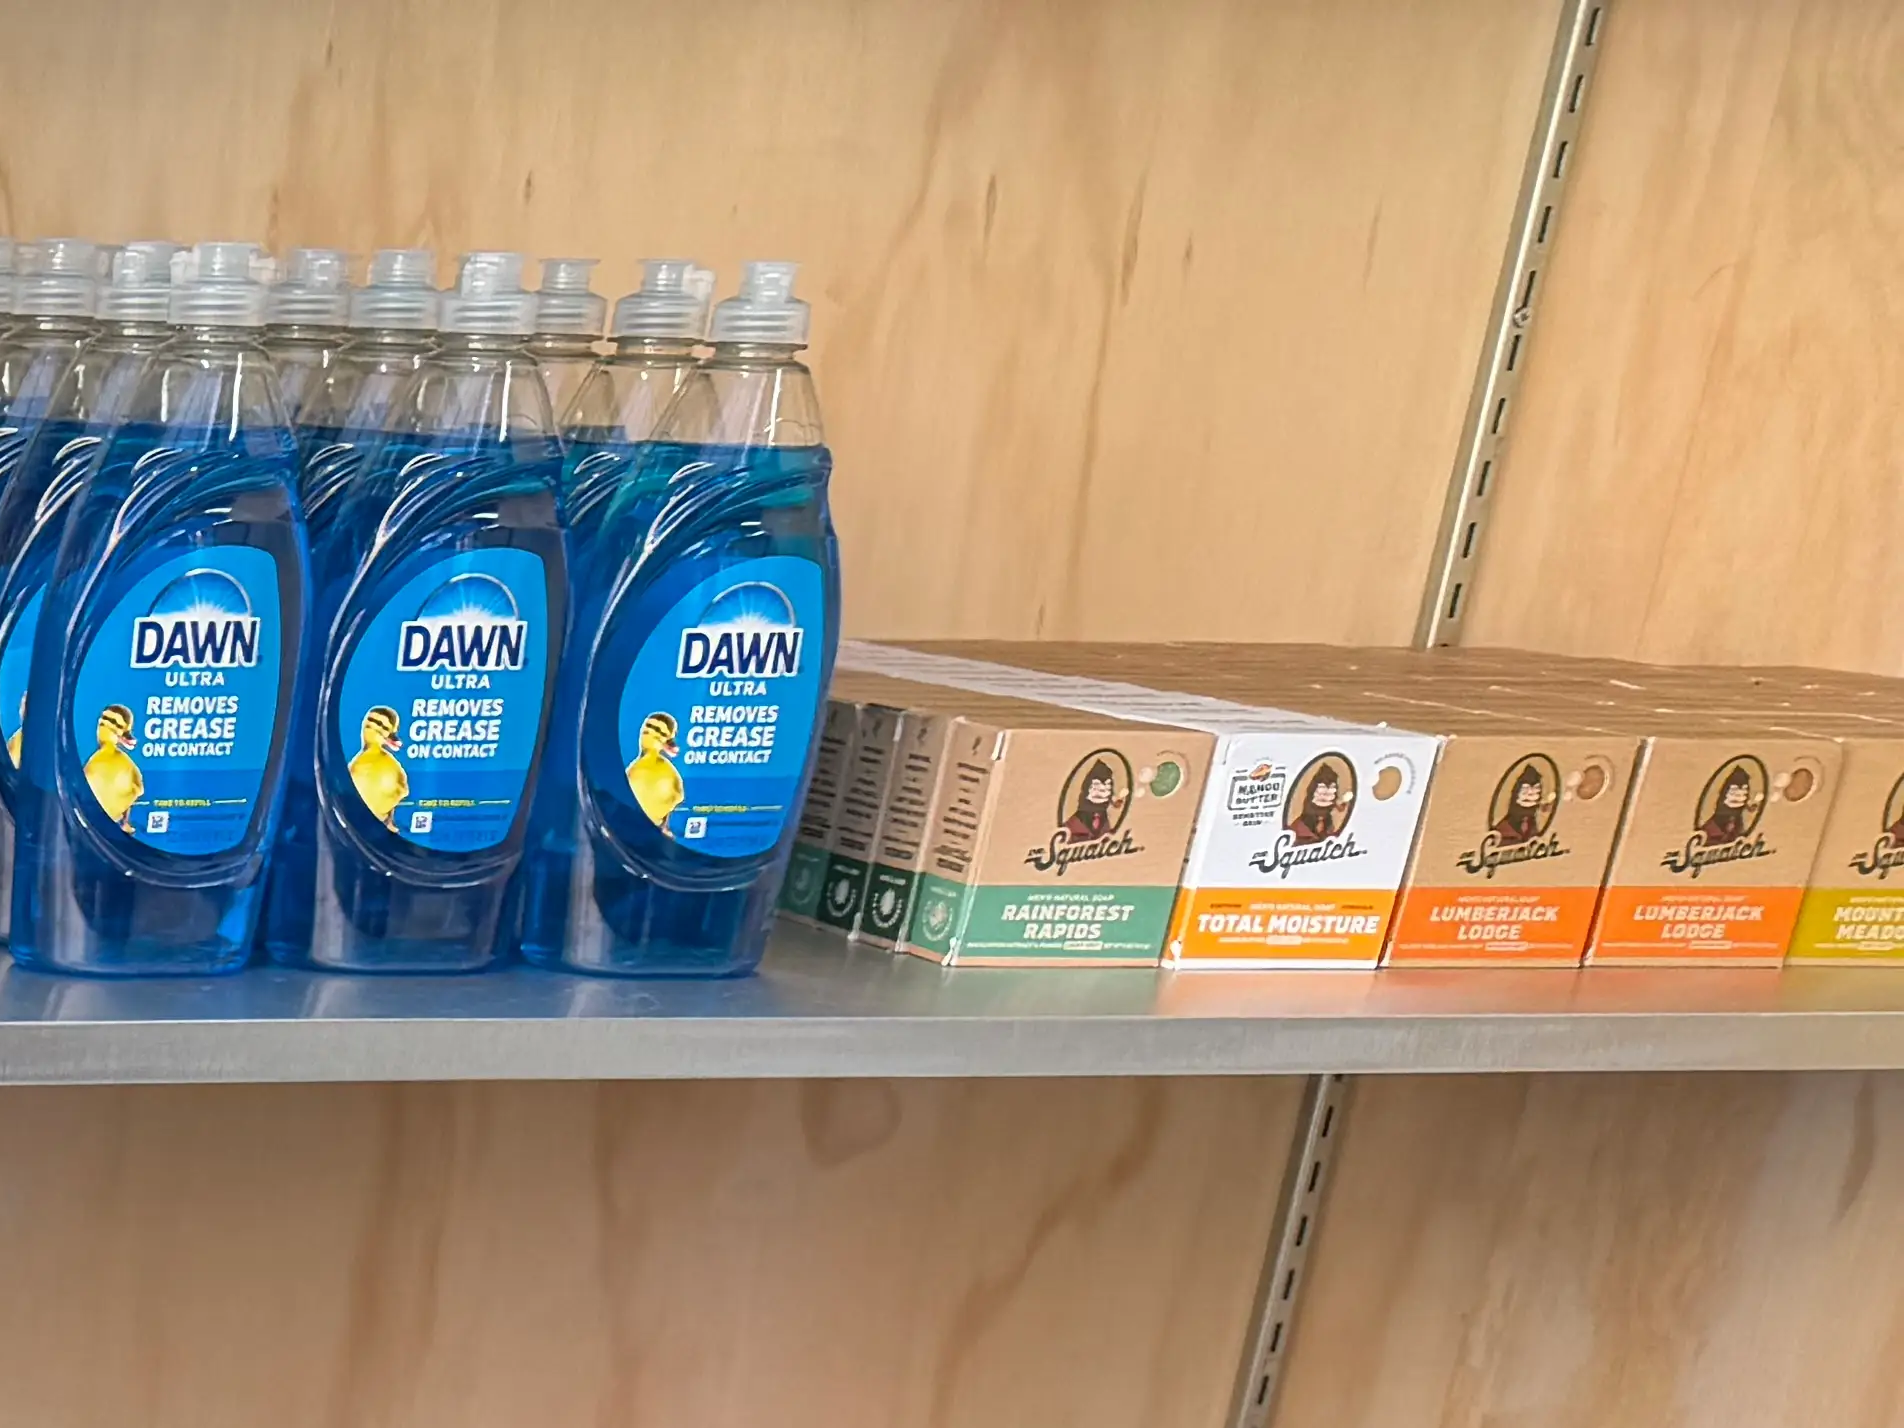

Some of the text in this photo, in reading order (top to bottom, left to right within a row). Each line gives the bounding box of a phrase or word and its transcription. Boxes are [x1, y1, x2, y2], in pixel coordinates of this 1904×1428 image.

[133, 619, 258, 666] DAWN
[399, 623, 525, 669] DAWN
[679, 630, 801, 676] DAWN
[165, 671, 224, 687] ULTRA
[431, 675, 491, 689] ULTRA
[710, 681, 767, 696] ULTRA
[146, 696, 239, 715] REMOVES
[412, 698, 504, 717] REMOVES
[690, 705, 779, 724] REMOVES
[144, 717, 236, 739] GREASE
[409, 719, 501, 742] GREASE
[686, 726, 776, 748] GREASE
[142, 741, 233, 757] ON CONTACT
[407, 743, 497, 759] ON CONTACT
[684, 749, 772, 764] ON CONTACT
[1001, 903, 1133, 922] RAINFOREST
[1429, 906, 1560, 923] LUMBERJACK
[1633, 905, 1764, 922] LUMBERJACK
[1022, 922, 1101, 940] RAPIDS
[1197, 914, 1380, 935] TOTAL MOISTURE
[1457, 924, 1521, 940] LODGE
[1661, 923, 1724, 939] LODGE
